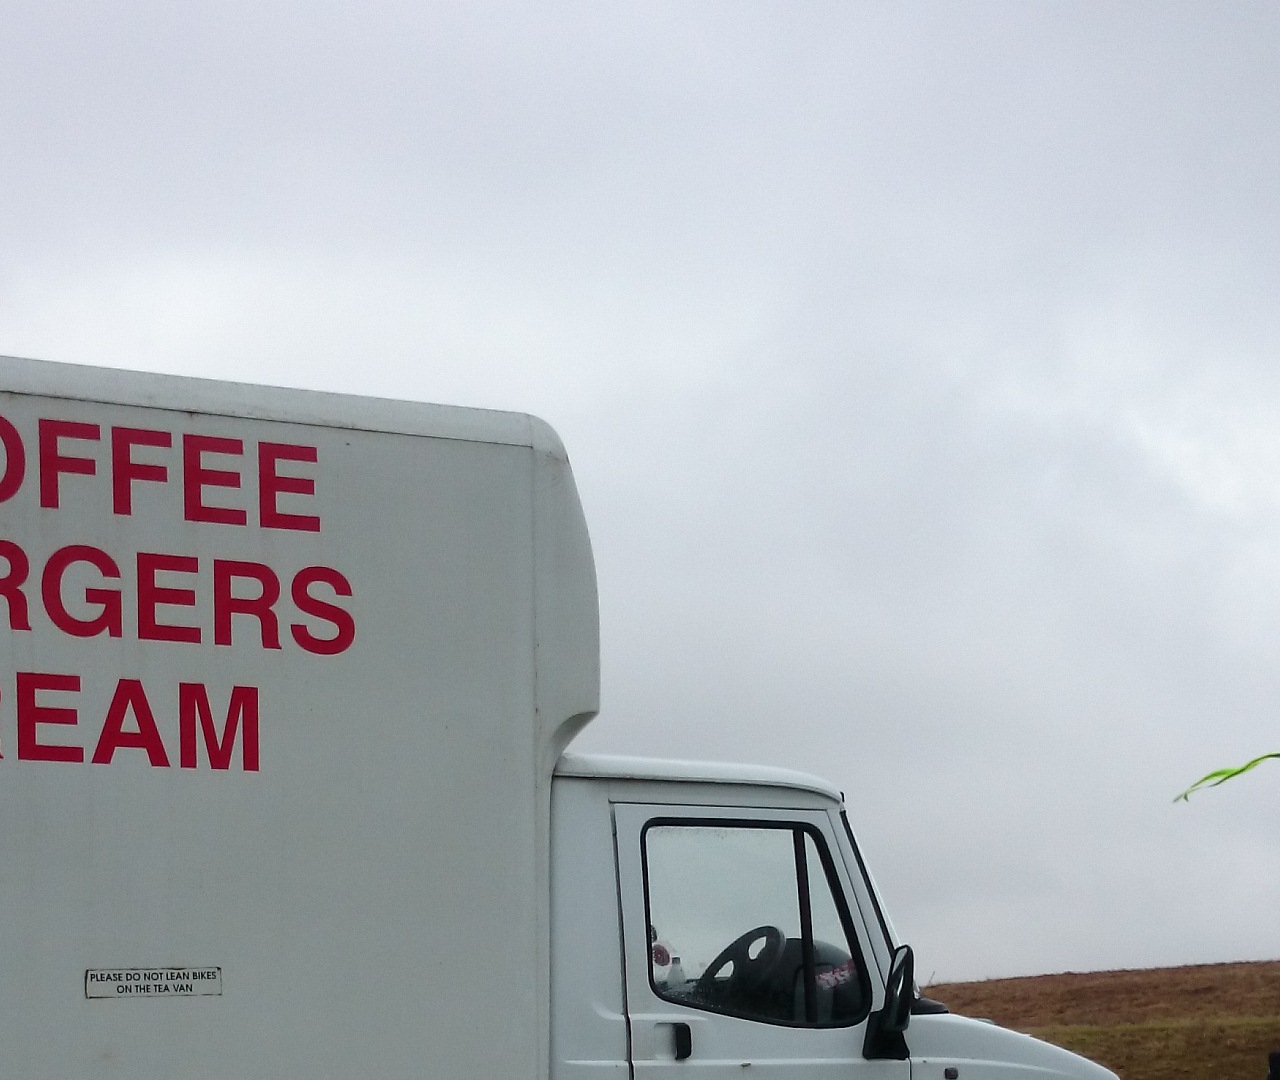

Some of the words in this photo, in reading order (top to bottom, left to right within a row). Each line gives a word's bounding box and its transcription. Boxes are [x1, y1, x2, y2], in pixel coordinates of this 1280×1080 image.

[90, 973, 123, 982] PLEASE
[125, 972, 141, 982] DO
[143, 972, 163, 981] NOT
[166, 971, 190, 981] LEAN
[192, 971, 217, 980] BIKES
[116, 985, 132, 994] ON
[135, 984, 151, 993] THE
[153, 984, 170, 993] TEA
[173, 984, 193, 992] VAN
